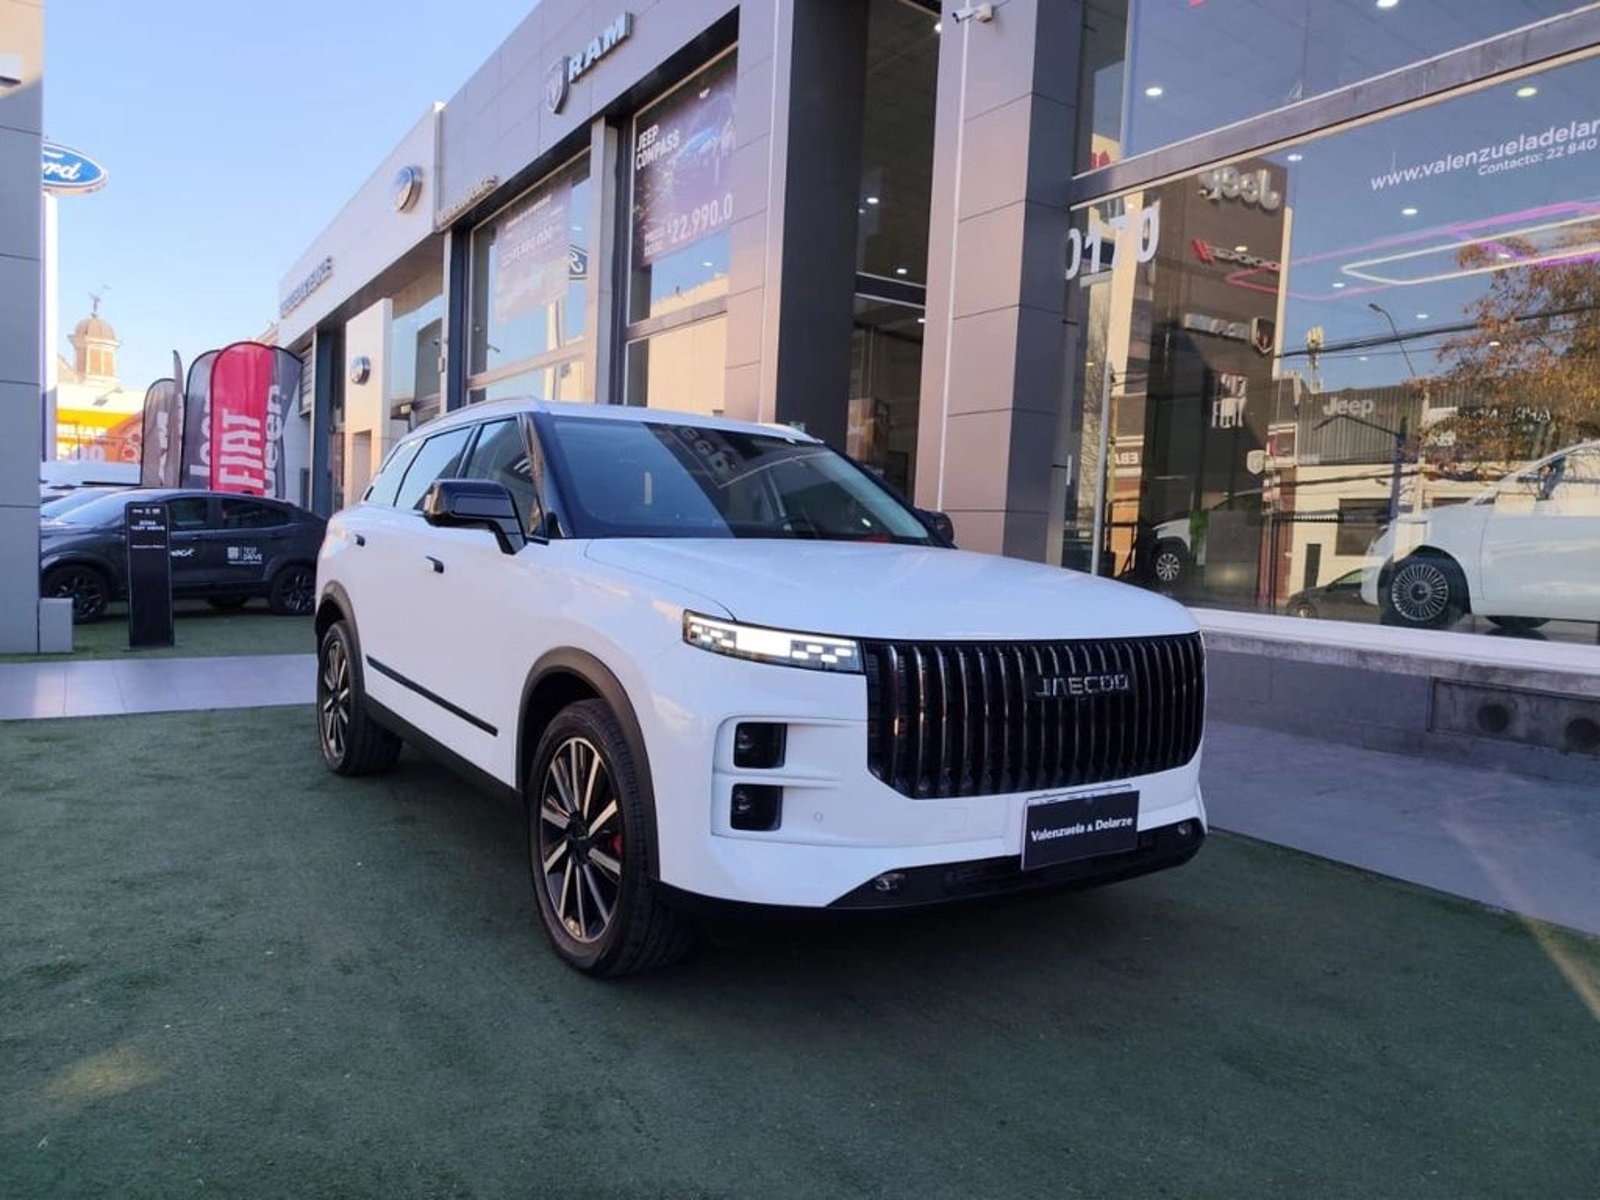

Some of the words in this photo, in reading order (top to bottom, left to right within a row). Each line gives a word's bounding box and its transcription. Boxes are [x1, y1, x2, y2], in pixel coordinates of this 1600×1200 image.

[568, 11, 632, 84] RAM
[636, 124, 659, 152] JEEP
[1370, 117, 1600, 191] www.valenzueladelar
[1478, 152, 1544, 176] Contacto:
[1322, 396, 1375, 417] Jeep
[218, 408, 264, 489] FIAT
[1030, 822, 1085, 842] Valenzuela
[1095, 817, 1133, 831] Delarze
